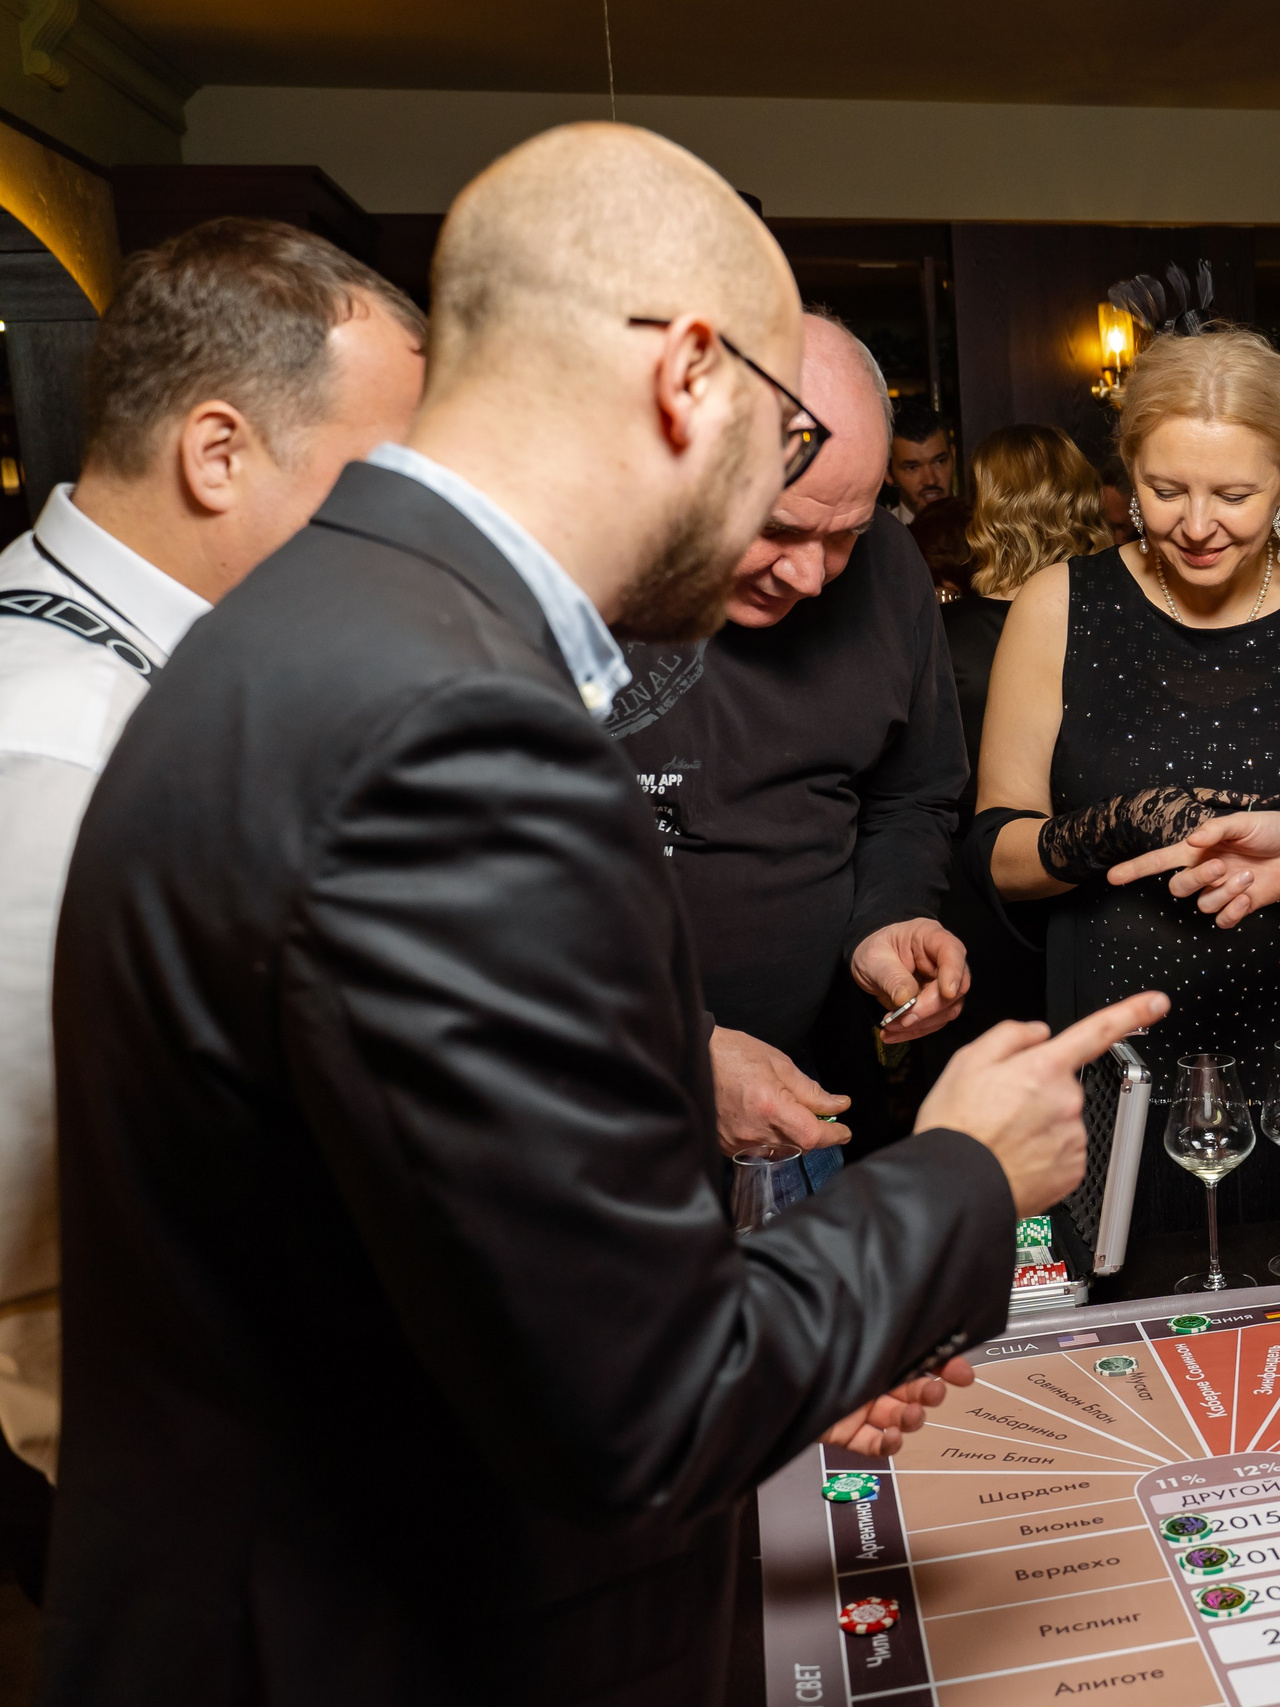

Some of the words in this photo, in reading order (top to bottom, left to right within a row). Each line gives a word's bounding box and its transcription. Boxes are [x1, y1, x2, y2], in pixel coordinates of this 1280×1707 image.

[985, 1342, 1039, 1356] США
[1174, 1342, 1206, 1381] Совиньон
[1026, 1372, 1086, 1407] Совиньон
[1081, 1403, 1118, 1425] Блан
[1125, 1371, 1154, 1402] Мускат
[1196, 1380, 1228, 1419] Каберне
[965, 1406, 1069, 1442] Альбариньо
[940, 1447, 997, 1462] Пино
[1002, 1452, 1056, 1465] Блан
[978, 1480, 1092, 1505] Шардоне
[1155, 1473, 1207, 1491] 11%
[856, 1501, 885, 1559] Аргентина
[1019, 1515, 1105, 1537] Вионье
[1014, 1556, 1121, 1582] Вердехо
[1038, 1611, 1142, 1638] Рислинг
[794, 1662, 824, 1702] СВЕТ
[1054, 1668, 1165, 1697] Алиготе
